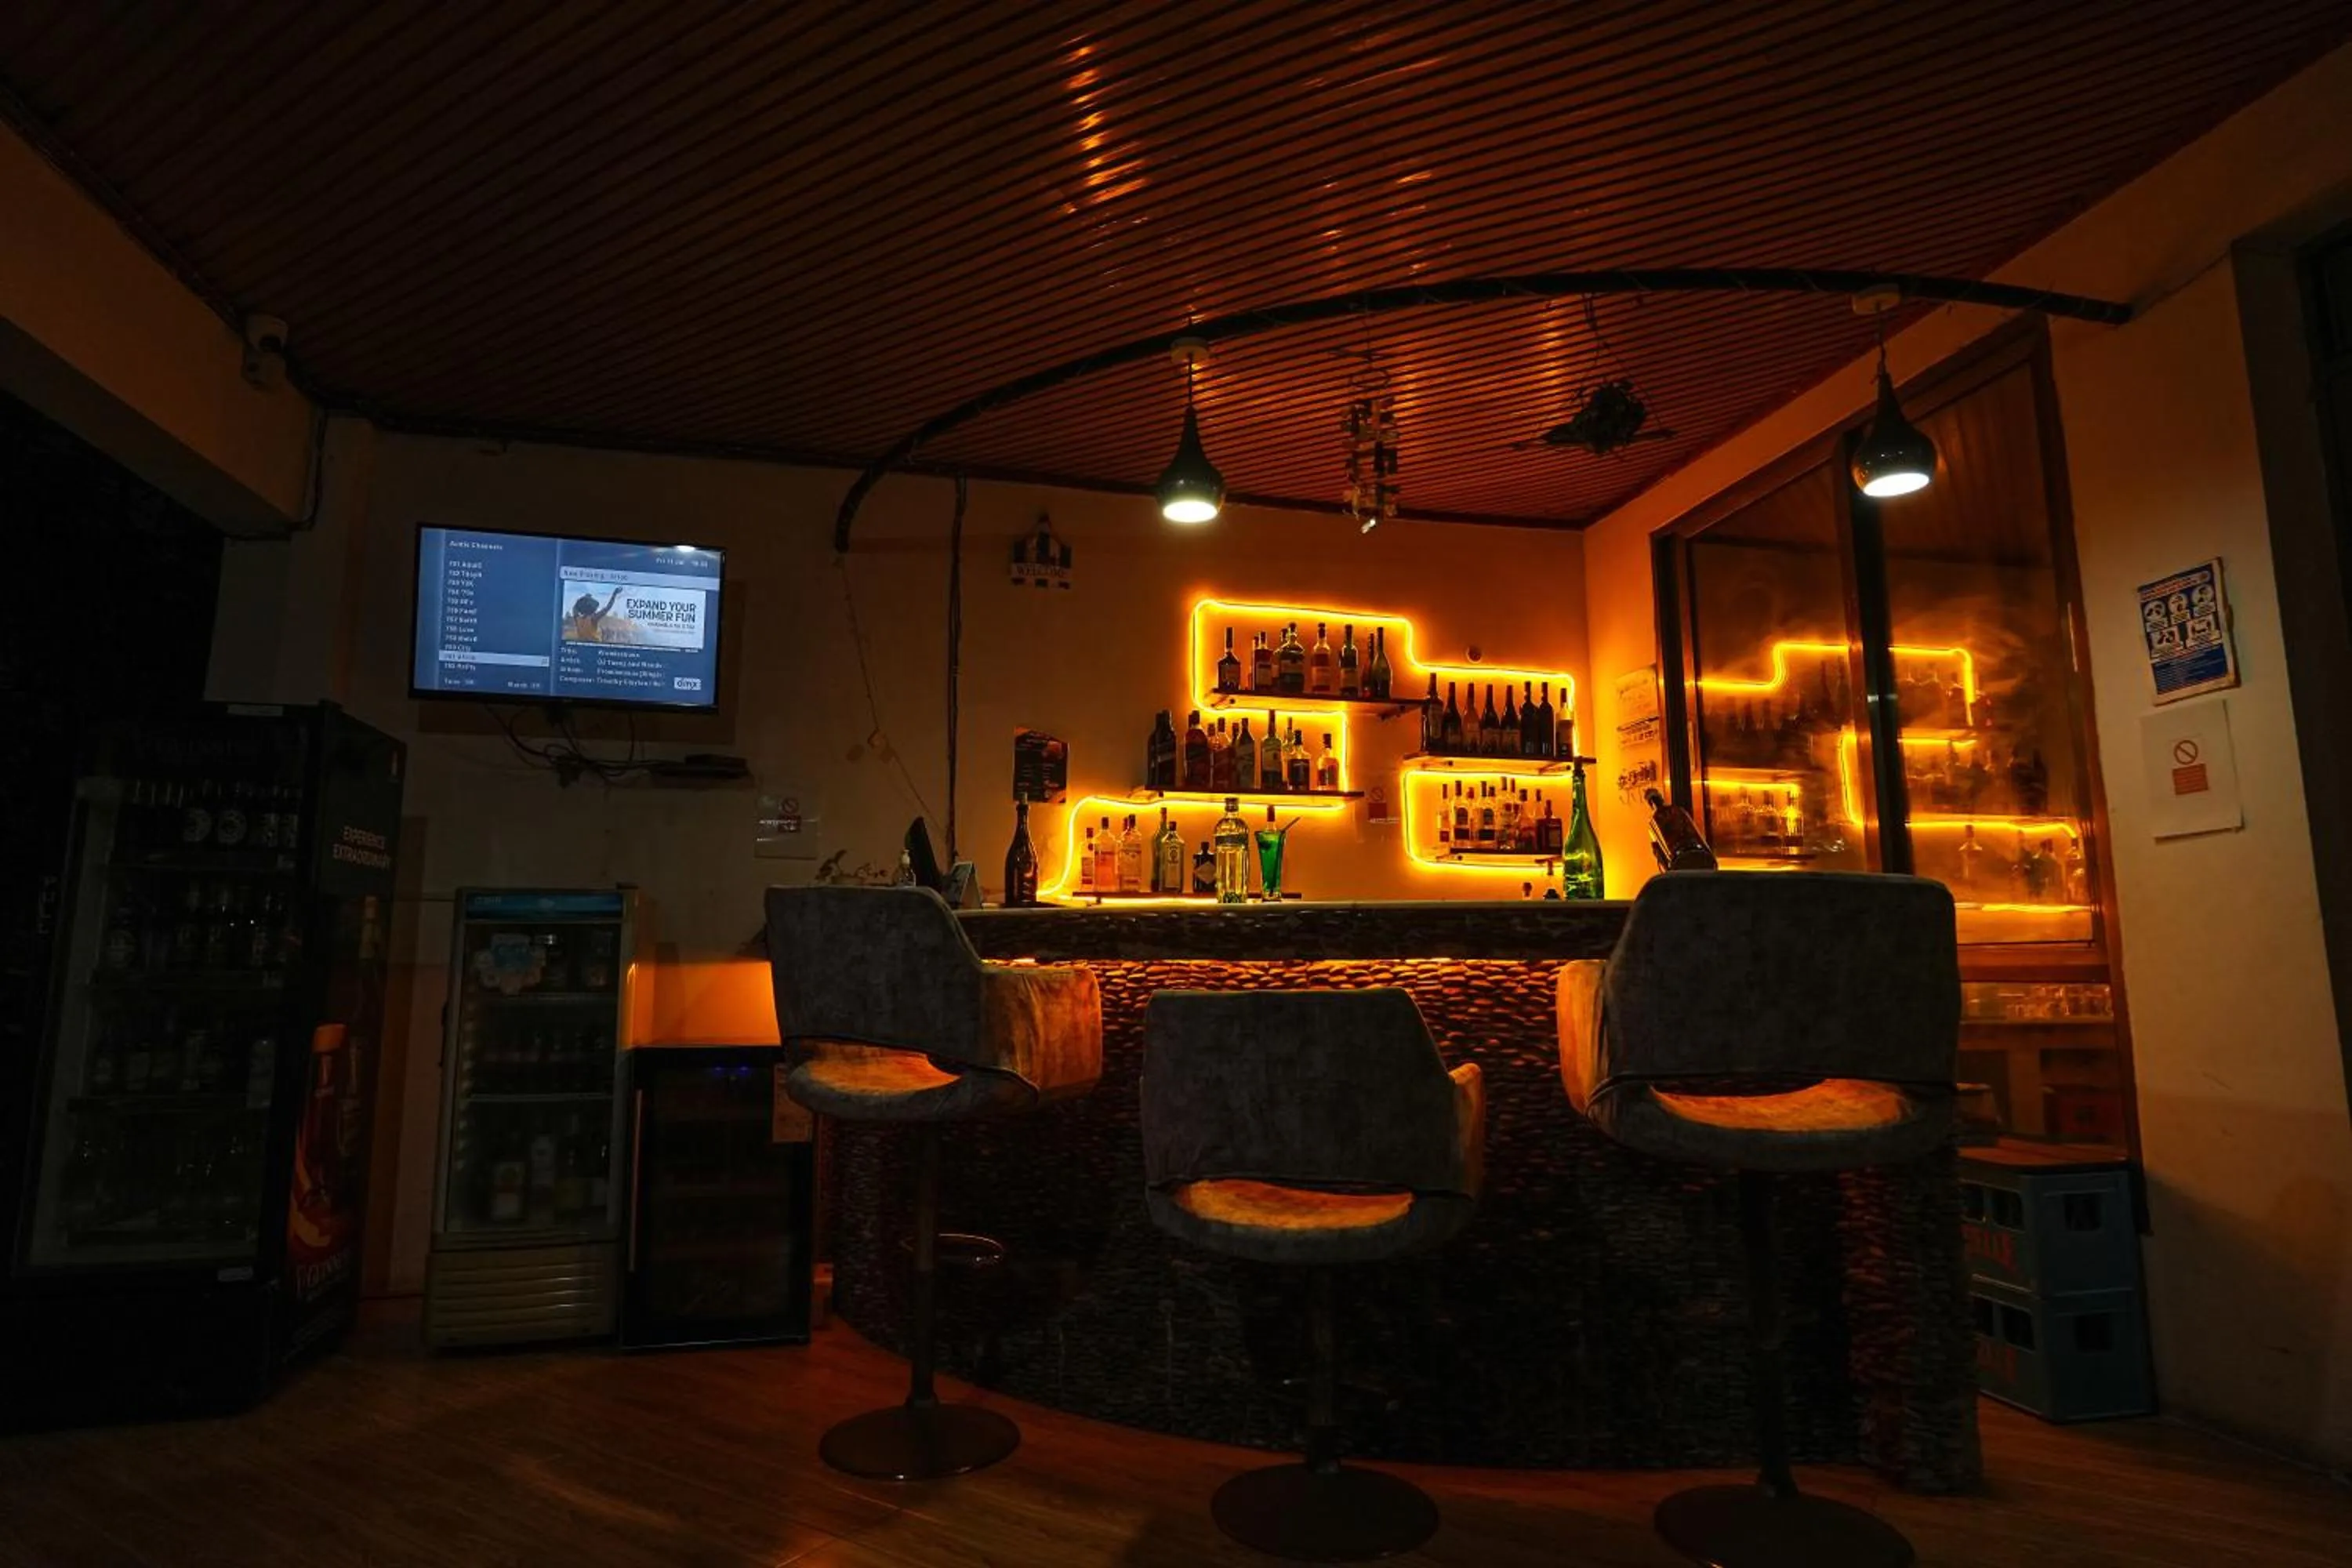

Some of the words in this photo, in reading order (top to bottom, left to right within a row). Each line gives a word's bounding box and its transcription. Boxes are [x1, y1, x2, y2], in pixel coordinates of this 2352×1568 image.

[626, 598, 667, 611] EXPAND
[669, 601, 697, 613] YOUR
[627, 609, 673, 622] SUMMER
[675, 613, 696, 623] FUN
